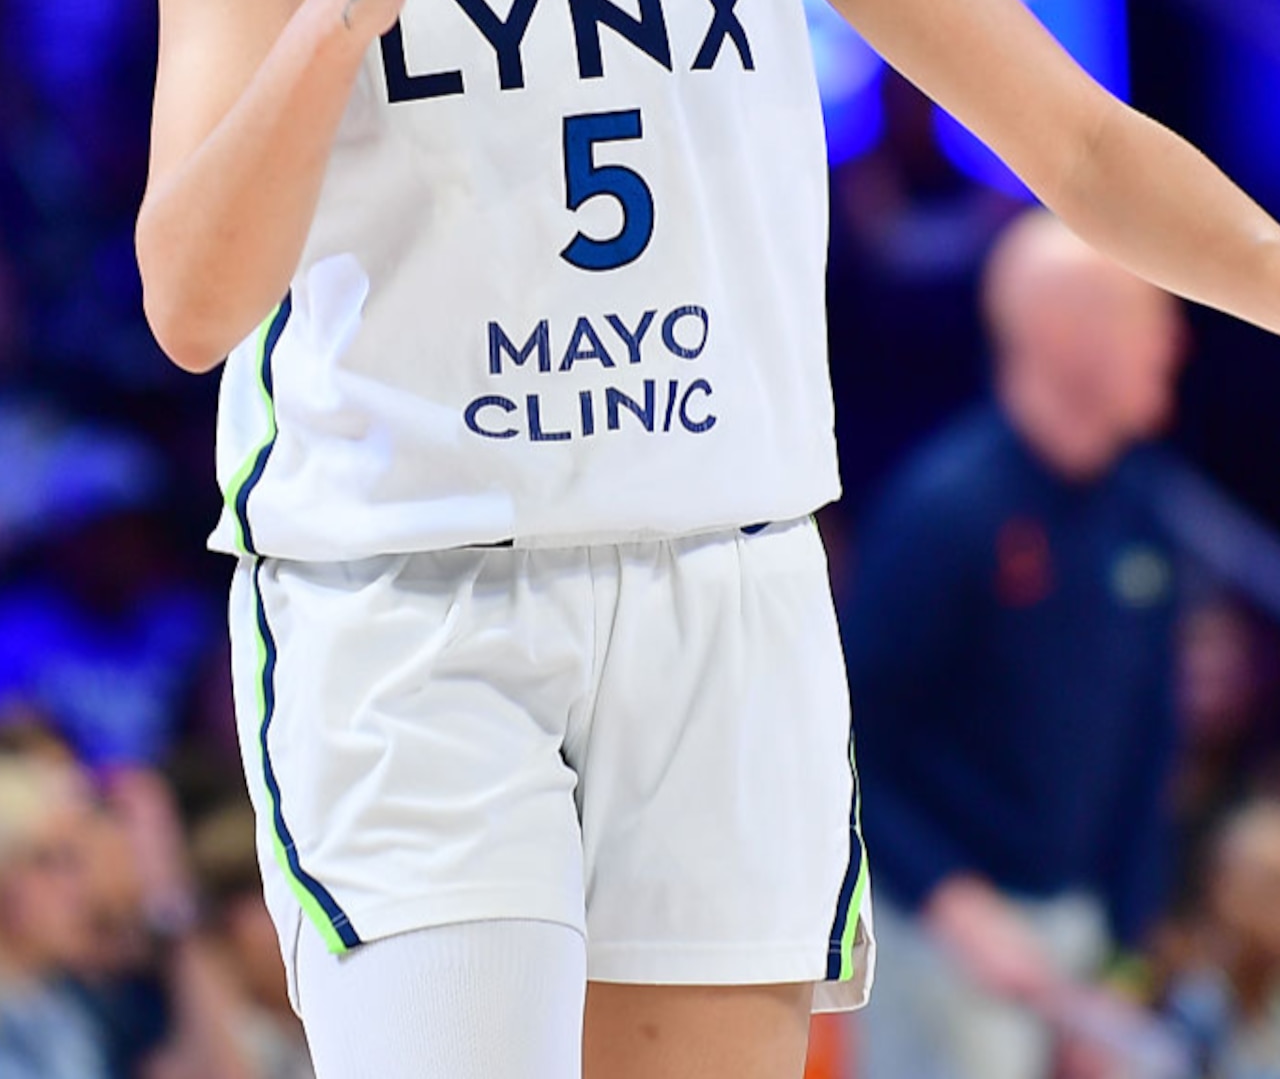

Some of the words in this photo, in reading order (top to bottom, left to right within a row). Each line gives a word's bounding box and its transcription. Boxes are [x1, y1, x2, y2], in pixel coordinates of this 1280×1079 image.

[559, 108, 655, 272] 5
[488, 305, 709, 375] MAYO
[464, 378, 717, 441] CLINIC
